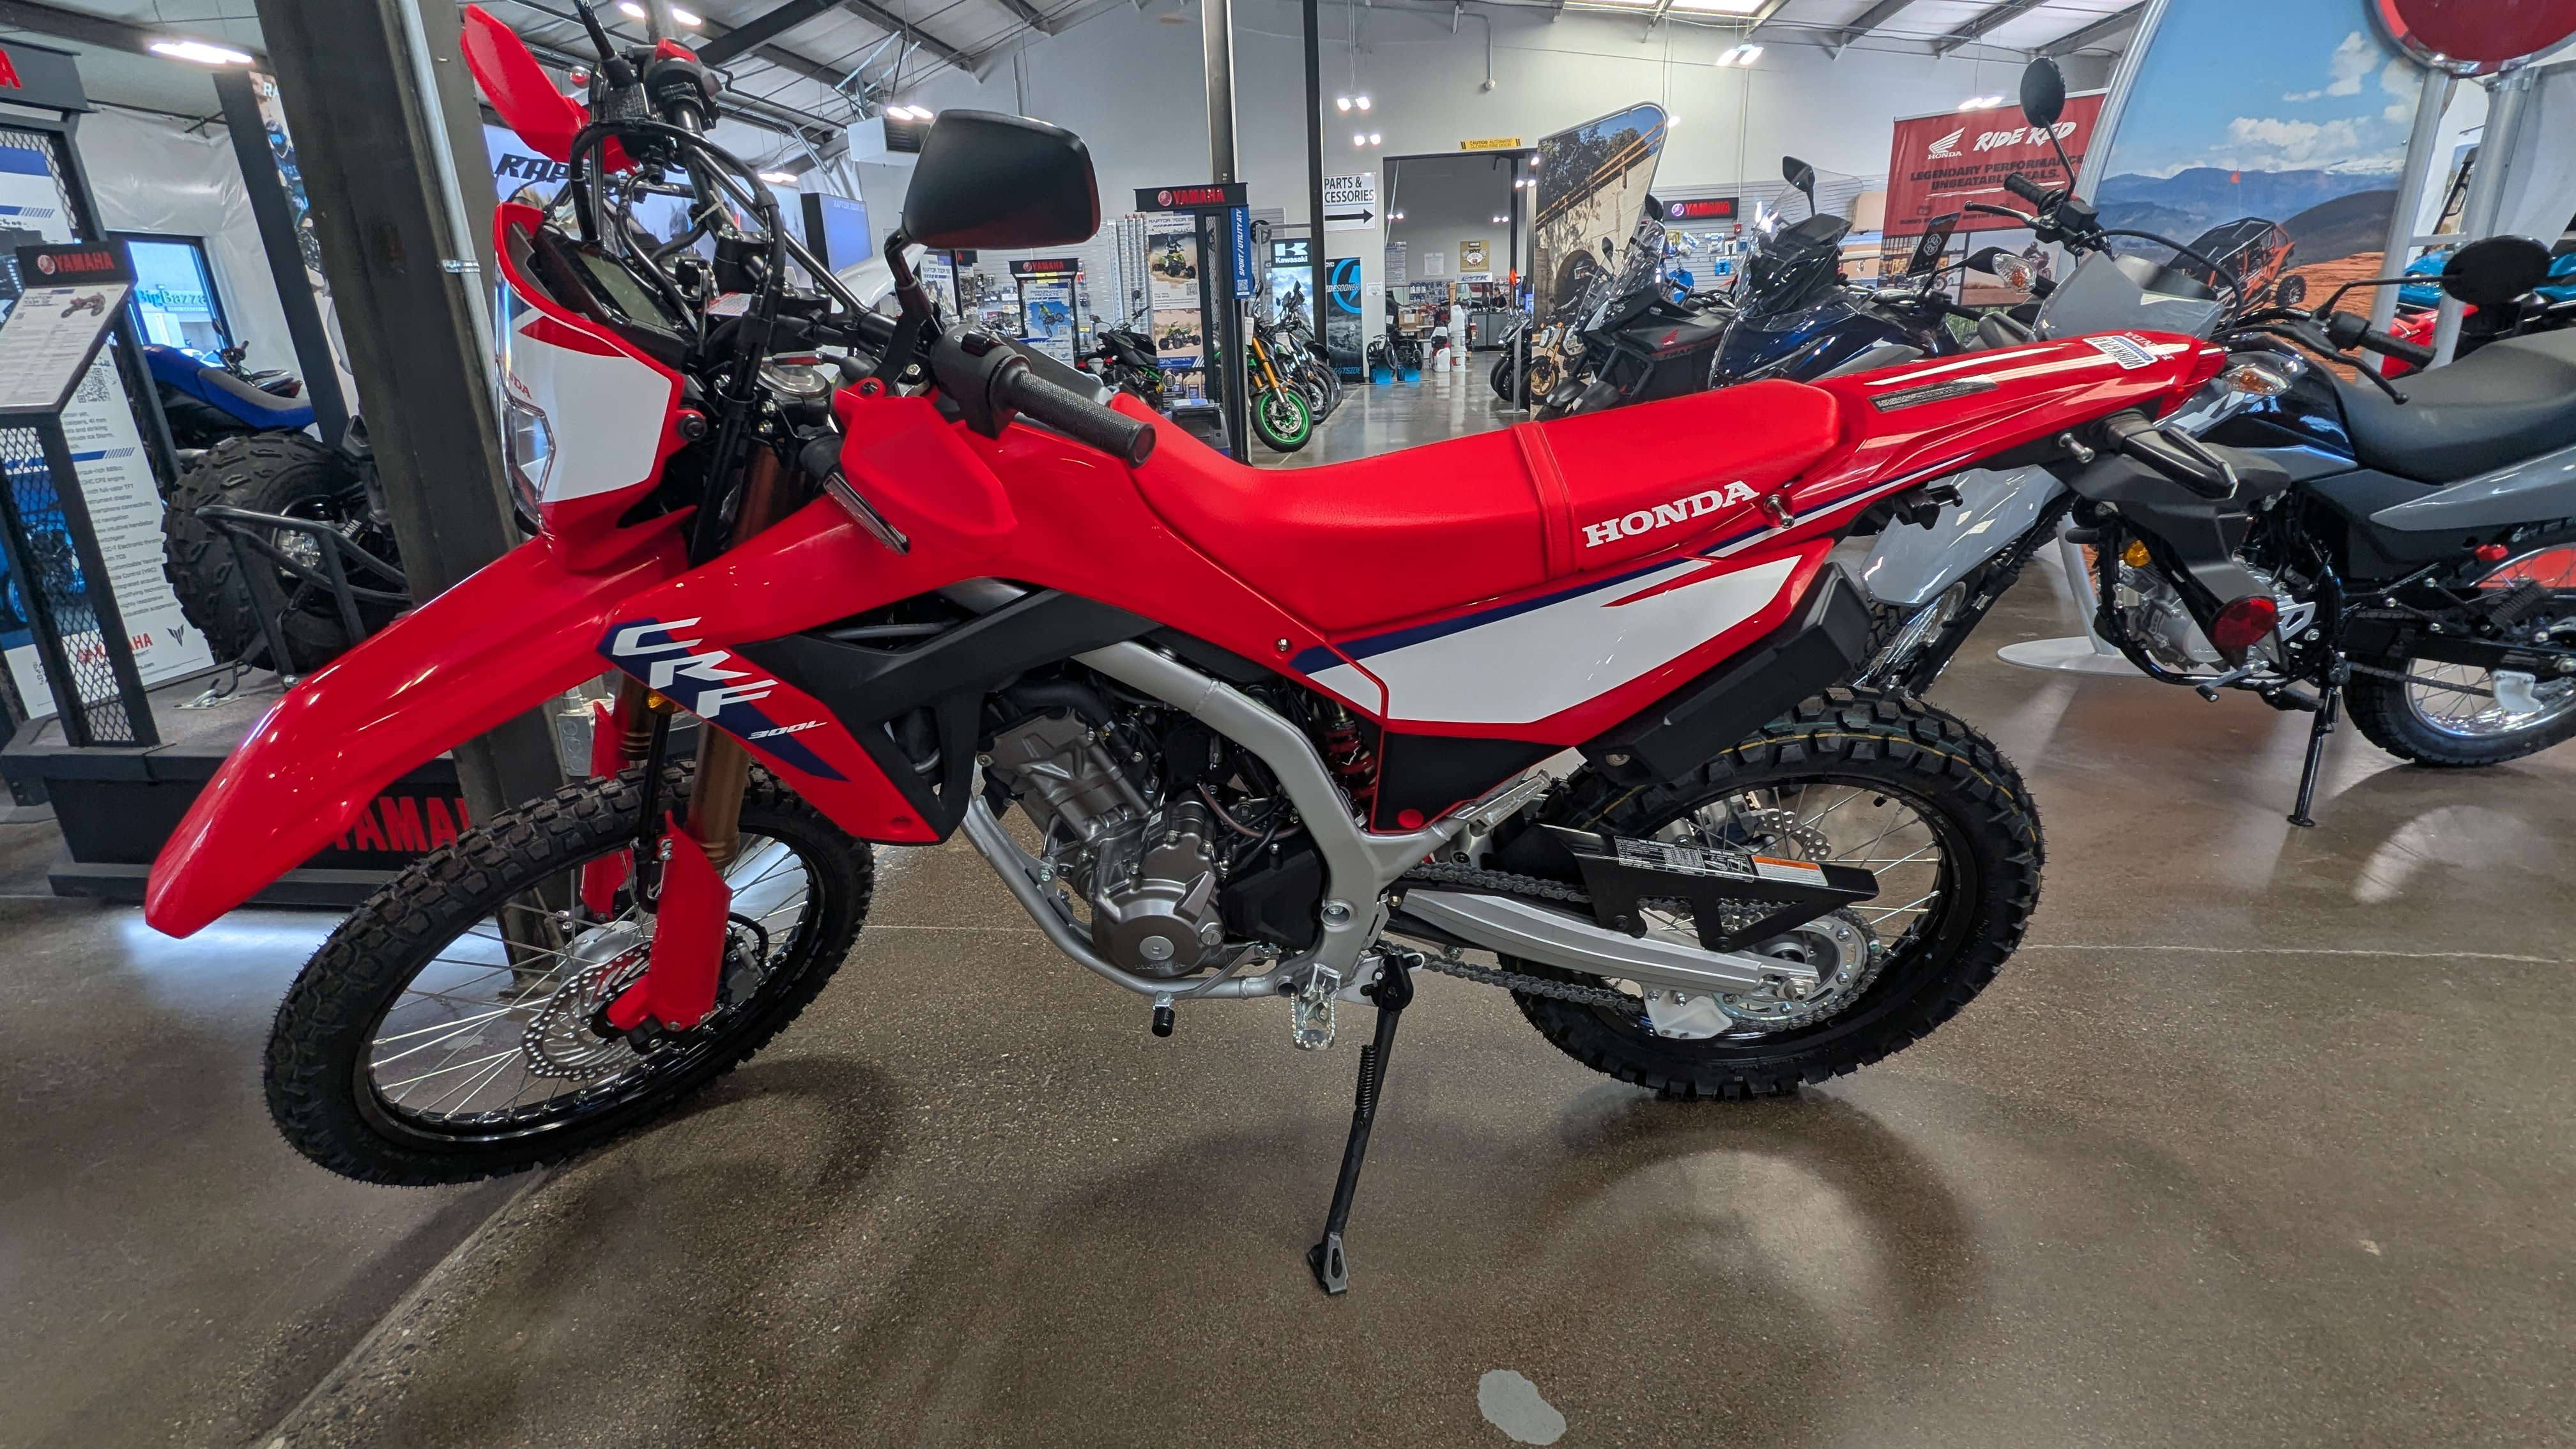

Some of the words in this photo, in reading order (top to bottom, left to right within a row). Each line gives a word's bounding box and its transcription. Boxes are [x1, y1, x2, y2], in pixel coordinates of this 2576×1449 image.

[1973, 126, 2028, 152] RIDE
[1928, 151, 1962, 160] HONDA
[1910, 165, 1981, 181] LEGENDARY
[1931, 172, 2006, 190] UNBEATABL
[1324, 177, 1353, 190] PARTS
[1355, 176, 1362, 188] &
[1173, 187, 1225, 205] YAMAHA
[1324, 189, 1374, 203] CESSORIES
[1685, 201, 1730, 215] YAMAHA
[52, 251, 115, 273] YAMAHA
[1032, 261, 1065, 271] YAMAHA
[1326, 283, 1361, 293] IDESOONER
[1582, 480, 1760, 548] HONDA
[611, 617, 778, 719] CRF
[747, 720, 828, 740] 300L
